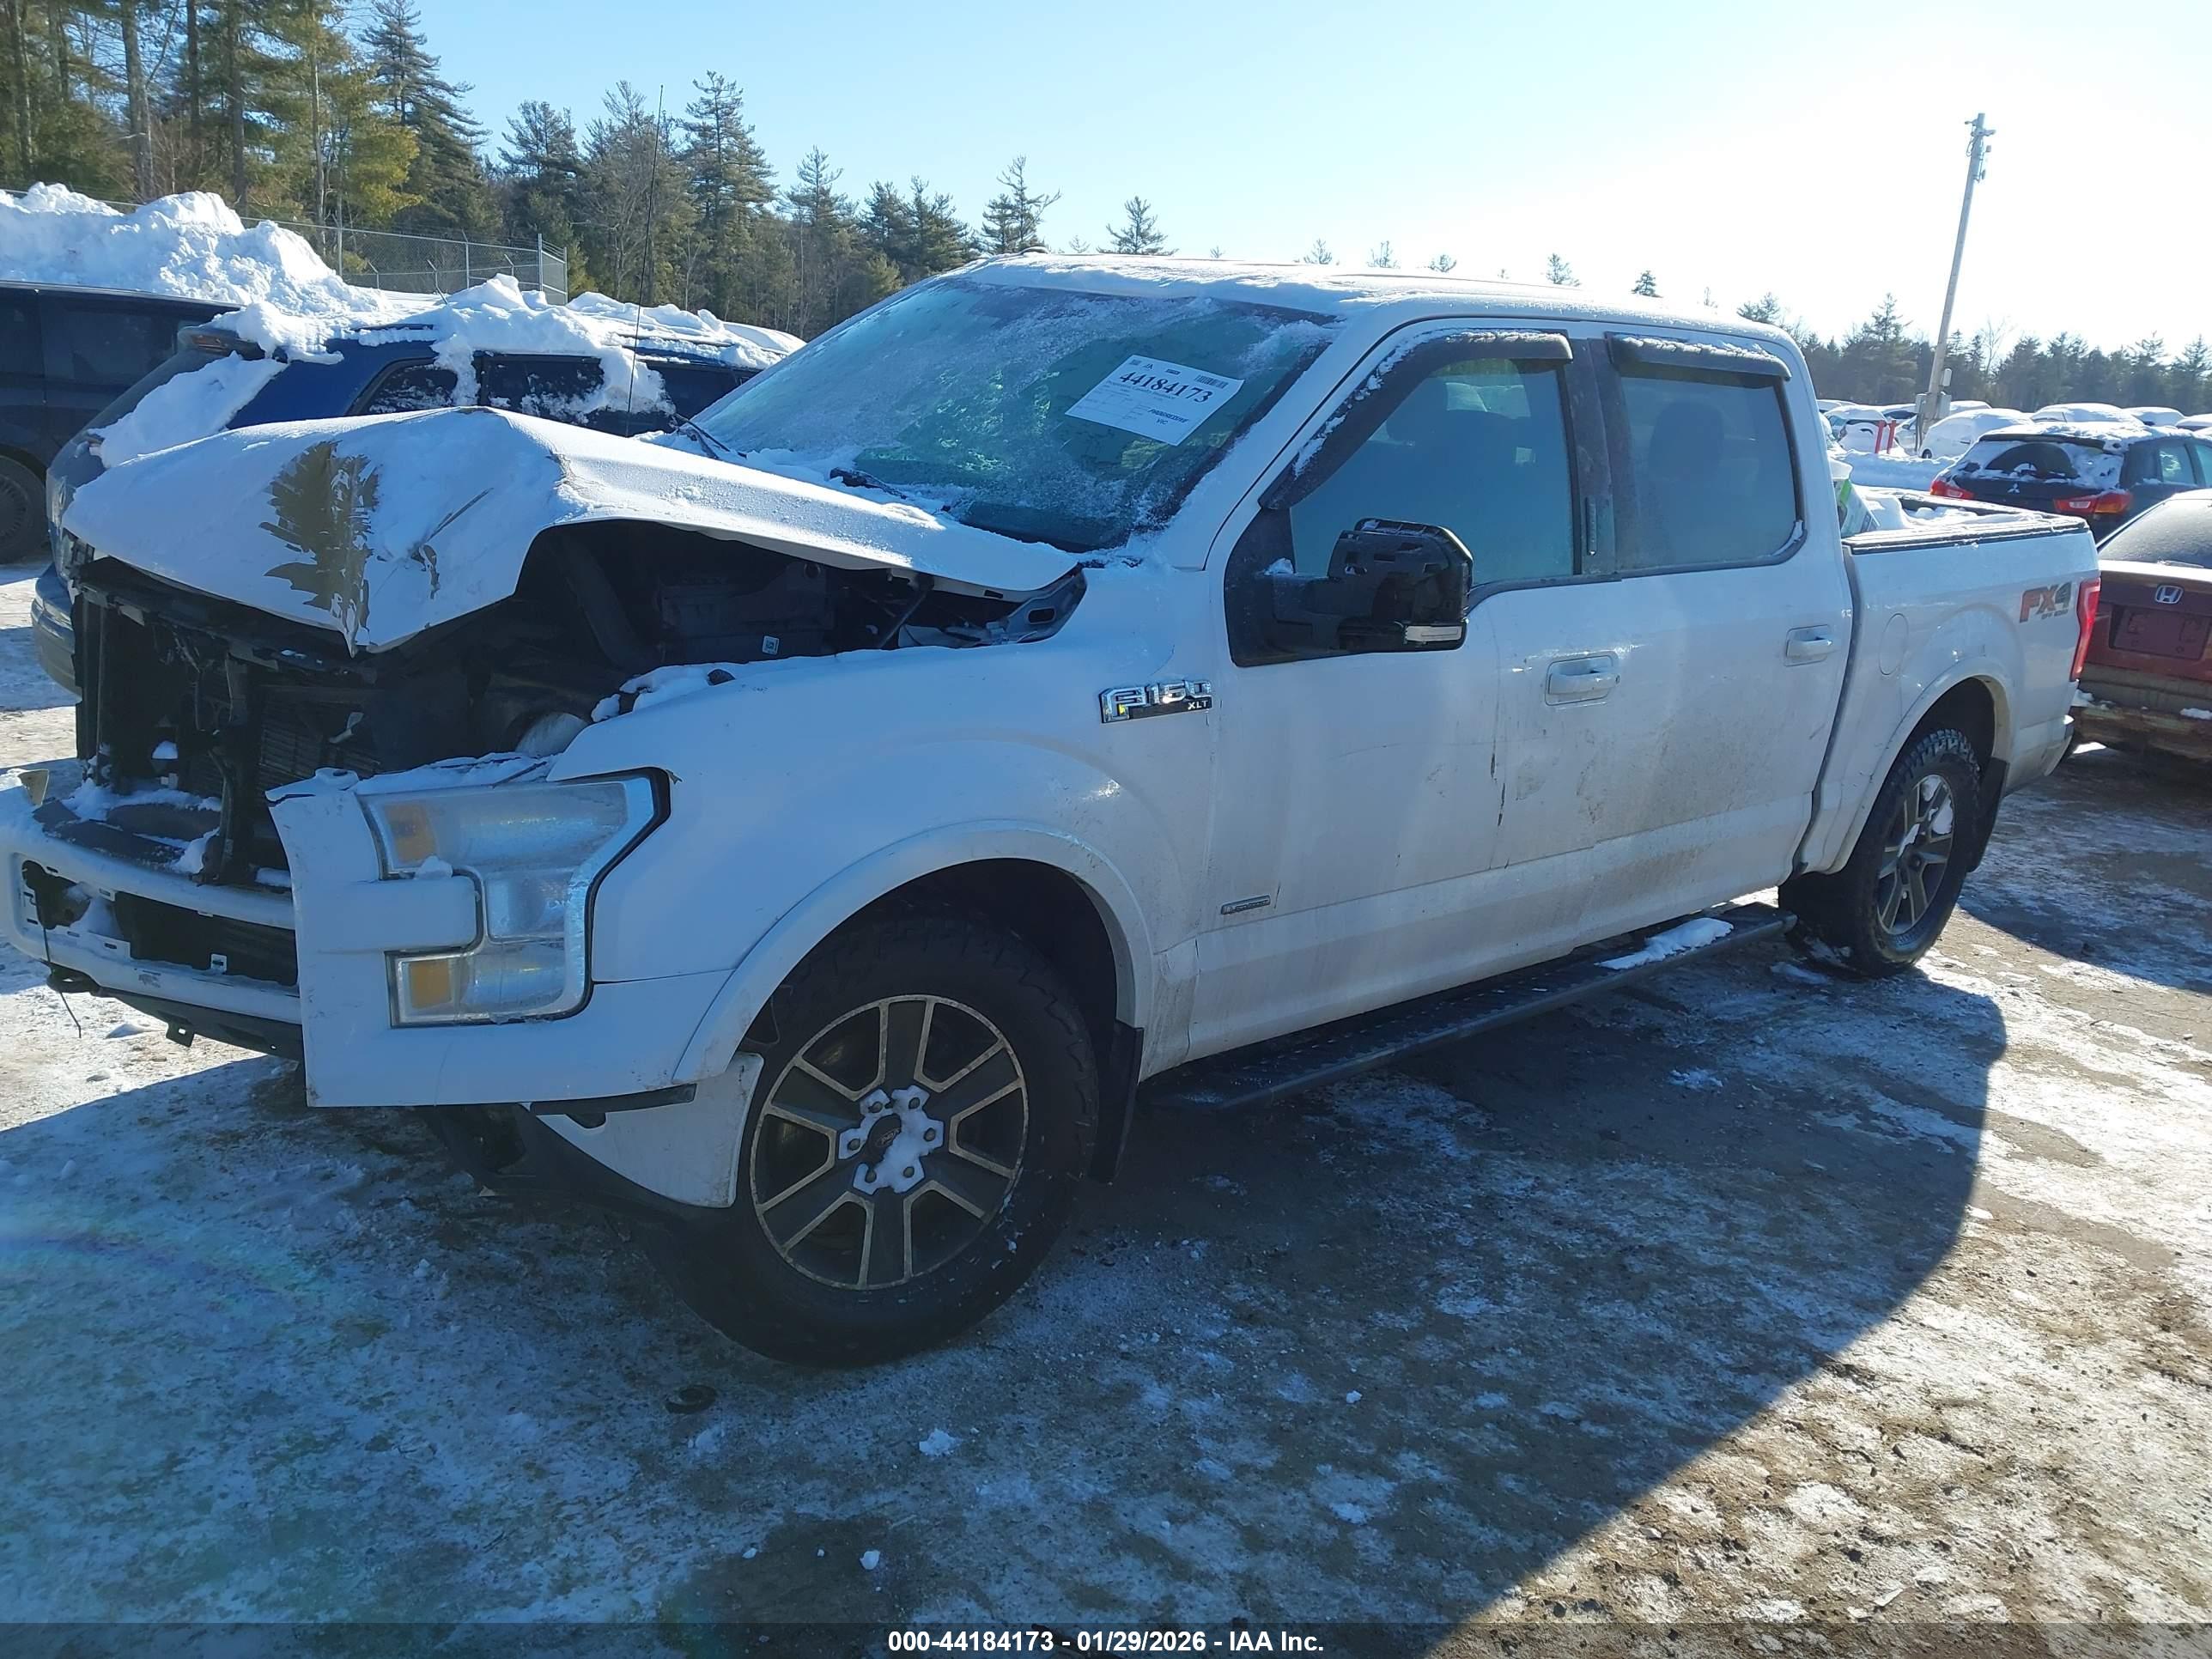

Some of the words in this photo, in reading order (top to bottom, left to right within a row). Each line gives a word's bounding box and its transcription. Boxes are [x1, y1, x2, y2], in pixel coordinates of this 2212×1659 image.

[1119, 371, 1212, 403] 44184173
[2019, 581, 2072, 623] FX4
[1188, 699, 1208, 710] XLT
